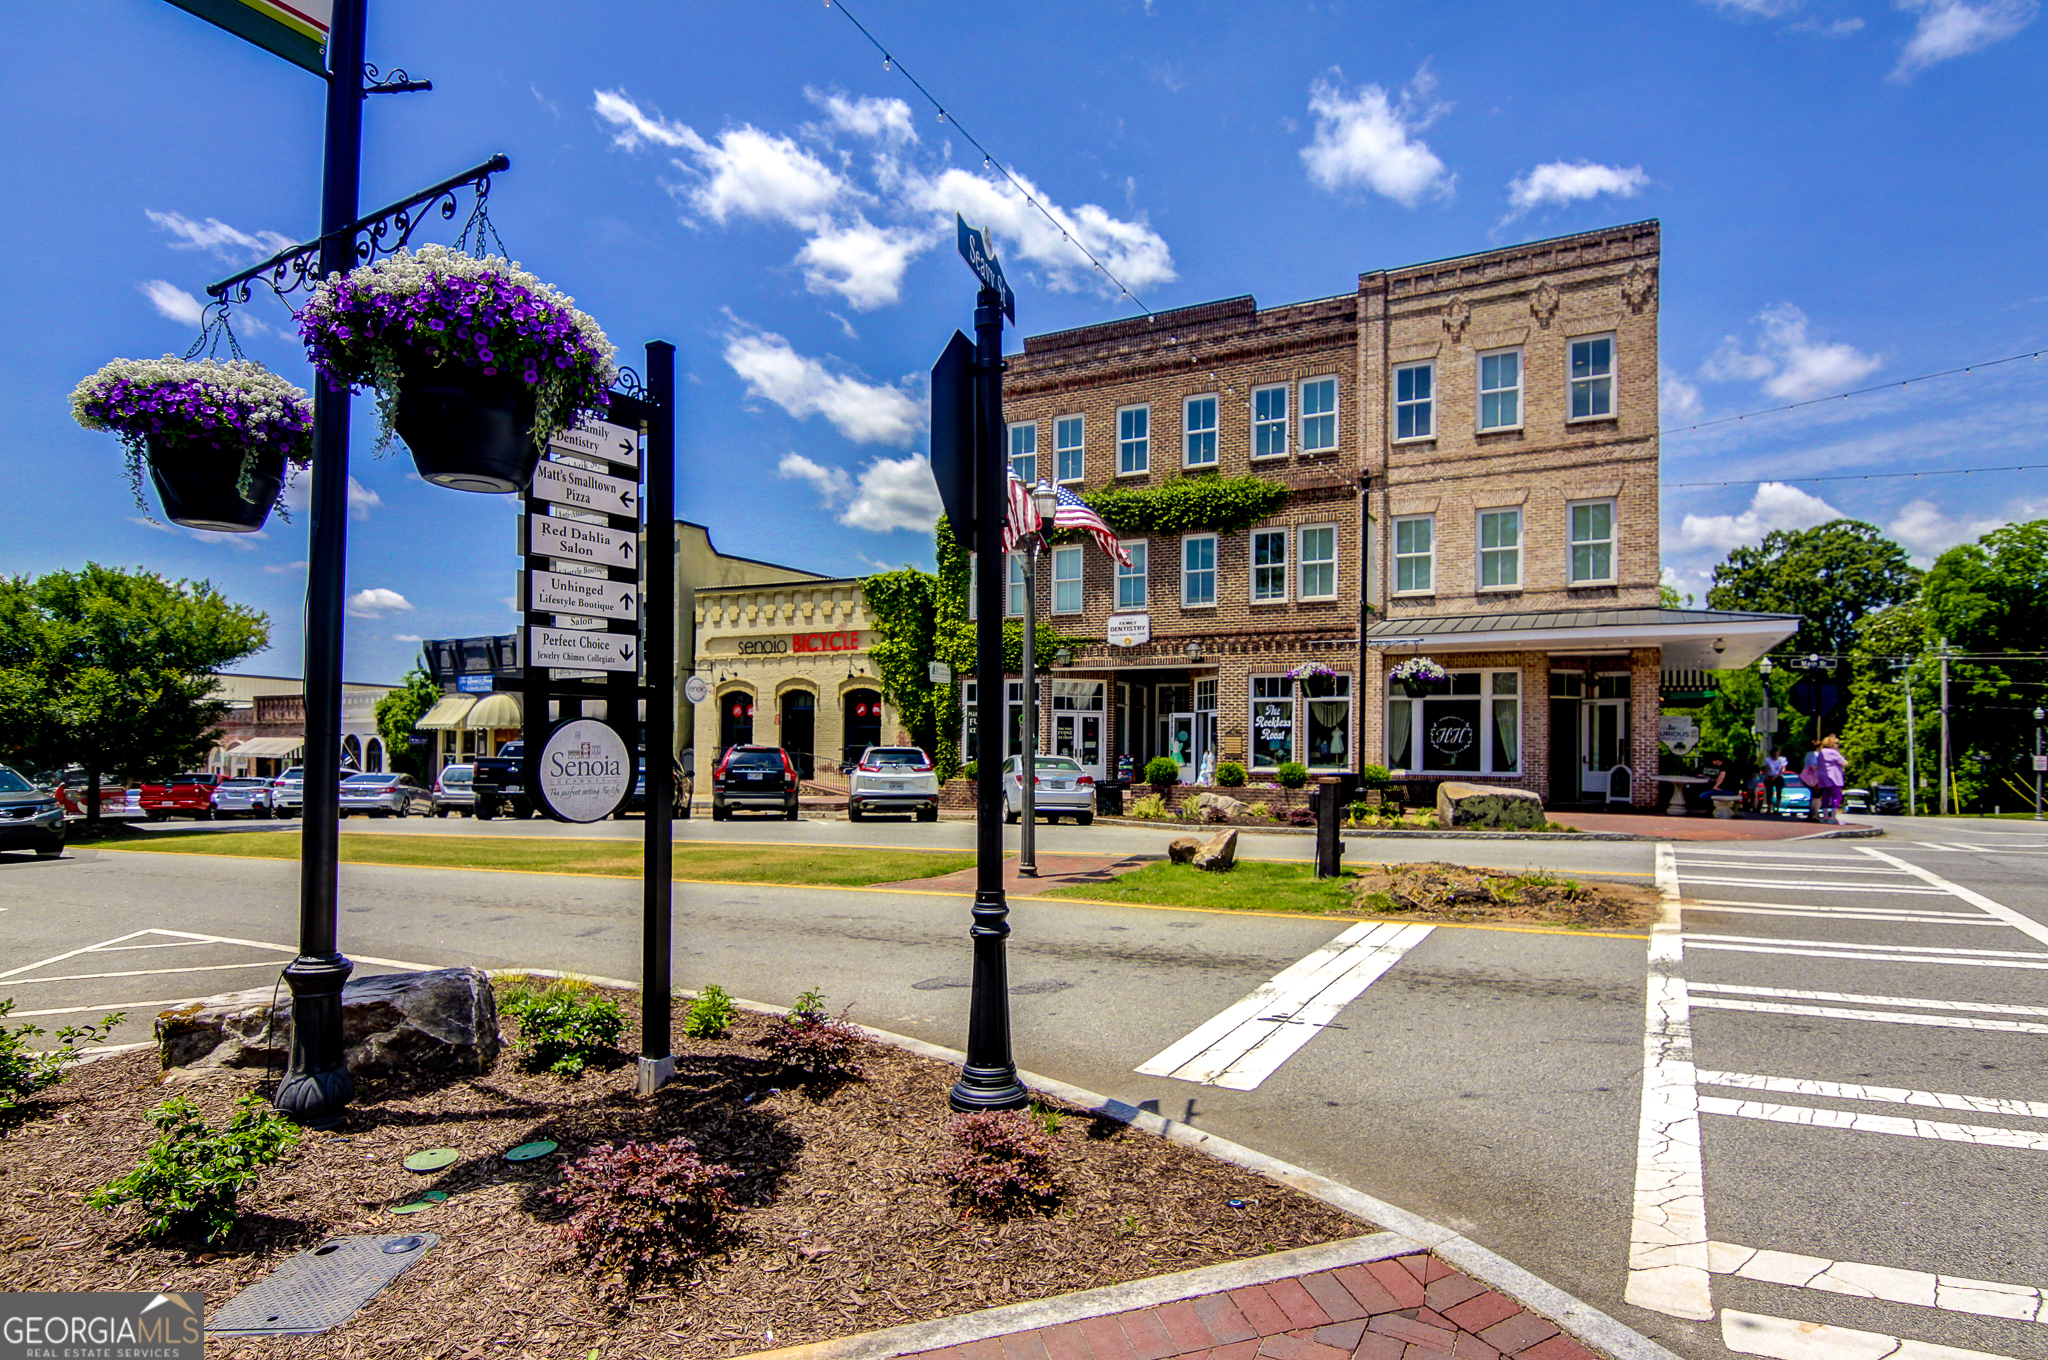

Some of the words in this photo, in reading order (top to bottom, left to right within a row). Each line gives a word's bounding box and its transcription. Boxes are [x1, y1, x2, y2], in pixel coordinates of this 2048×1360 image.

[969, 234, 996, 288] Seavy
[997, 275, 1007, 308] St
[556, 431, 599, 454] Dentistry
[537, 465, 567, 482] Matt's
[568, 472, 617, 494] Smalltown
[566, 487, 591, 504] Pizza
[541, 522, 567, 538] Red
[571, 527, 611, 545] Dahlia
[560, 540, 593, 556] Salon
[551, 578, 604, 597] Unhinged
[539, 593, 576, 607] Lifestyle
[578, 596, 614, 612] Boutique
[570, 617, 593, 626] Salon
[543, 633, 576, 648] Perfect
[579, 636, 610, 650] Choice
[738, 636, 788, 655] senoia
[793, 631, 859, 653] BICYCLE
[537, 651, 560, 662] Jewelry
[562, 652, 585, 662] Chimes
[587, 653, 616, 664] Collegiate
[1265, 704, 1281, 715] The
[1255, 716, 1291, 727] Reckless
[1261, 728, 1285, 740] Roost
[550, 752, 621, 778] Senoia
[550, 788, 560, 796] The
[560, 786, 581, 799] perfect
